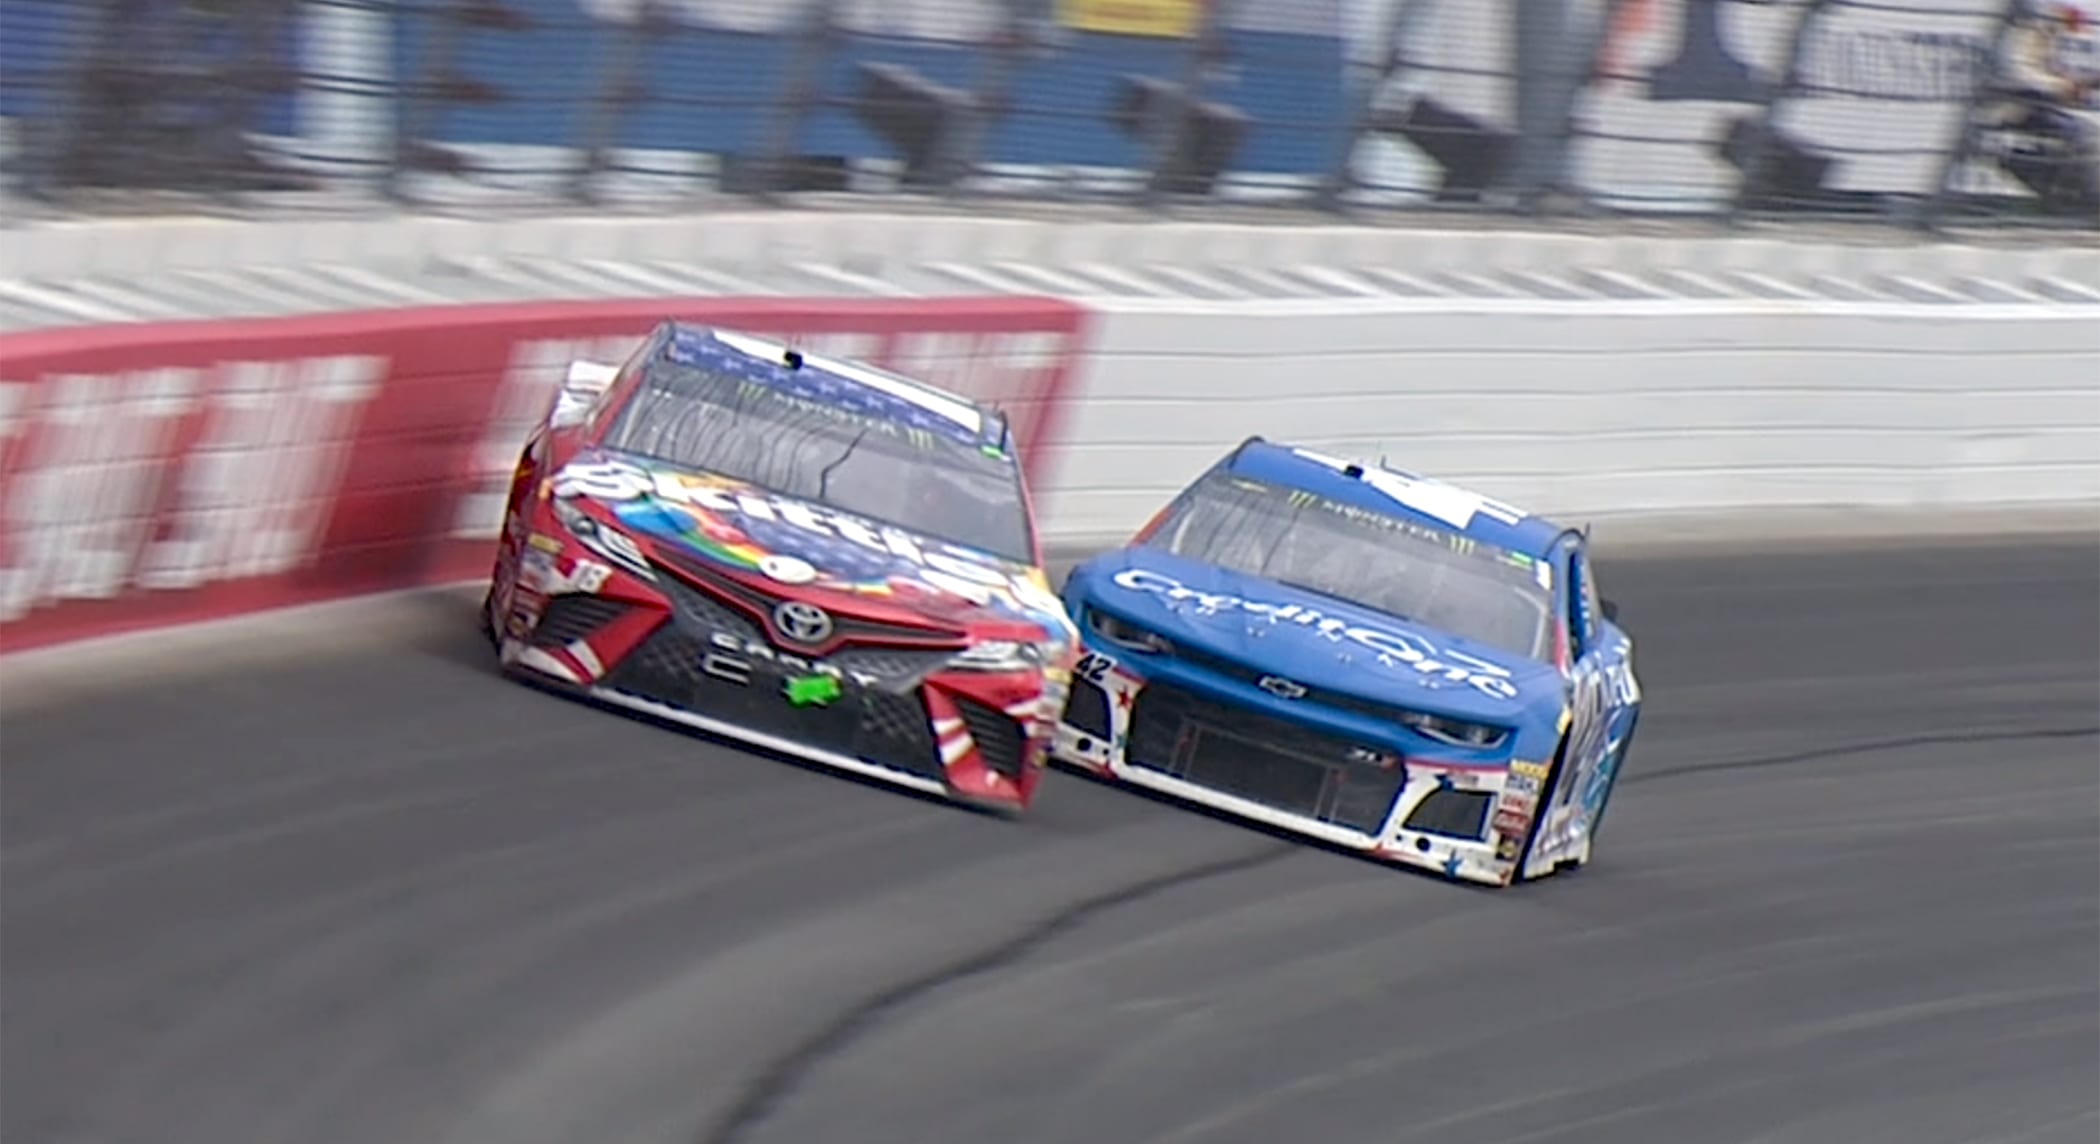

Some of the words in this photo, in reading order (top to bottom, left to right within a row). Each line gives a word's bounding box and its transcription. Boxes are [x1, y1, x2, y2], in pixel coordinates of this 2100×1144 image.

[773, 391, 898, 437] MONSTER
[1322, 501, 1441, 543] MONSTER
[1075, 653, 1112, 681] 42
